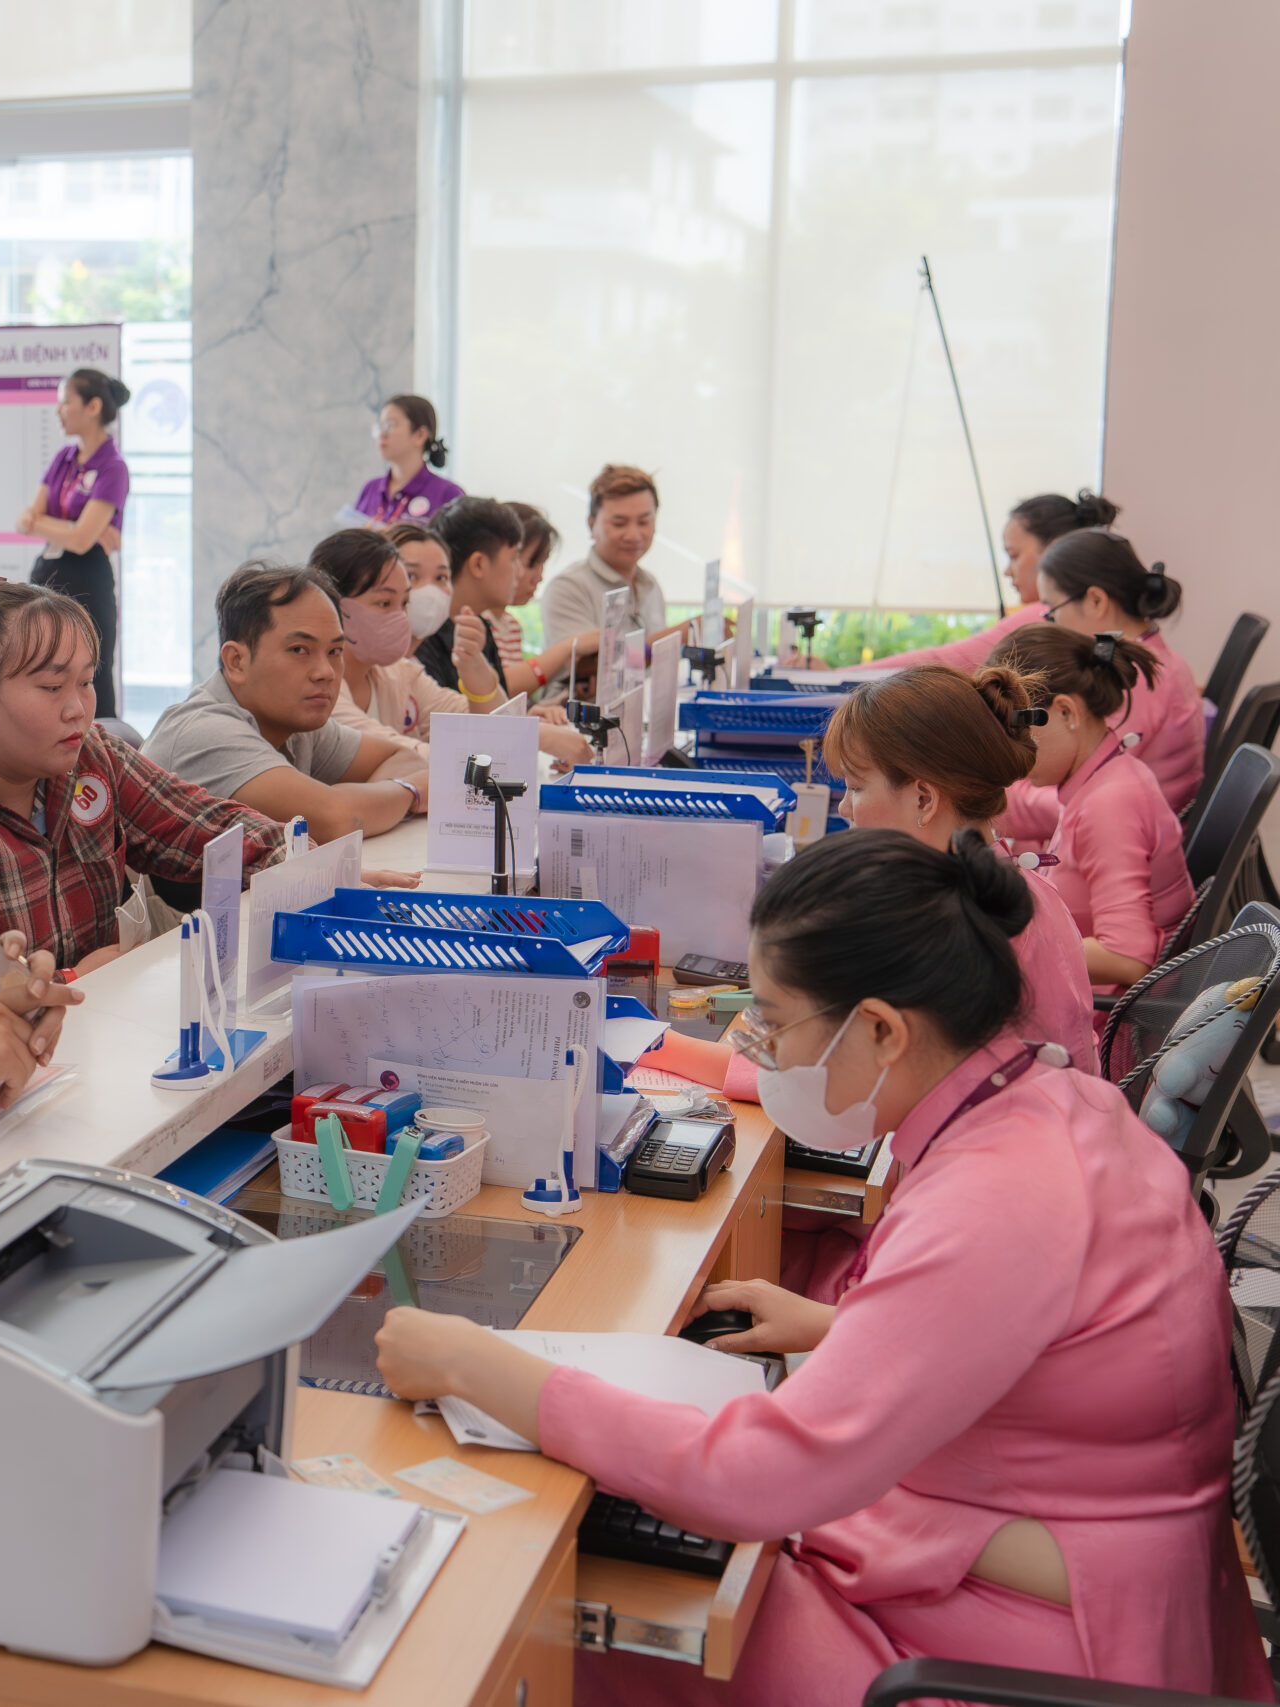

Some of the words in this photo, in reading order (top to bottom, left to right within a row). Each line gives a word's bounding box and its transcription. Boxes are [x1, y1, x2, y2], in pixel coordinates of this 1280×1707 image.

[23, 342, 67, 363] BỆNH
[72, 340, 109, 361] VIỆN
[73, 785, 98, 810] 60
